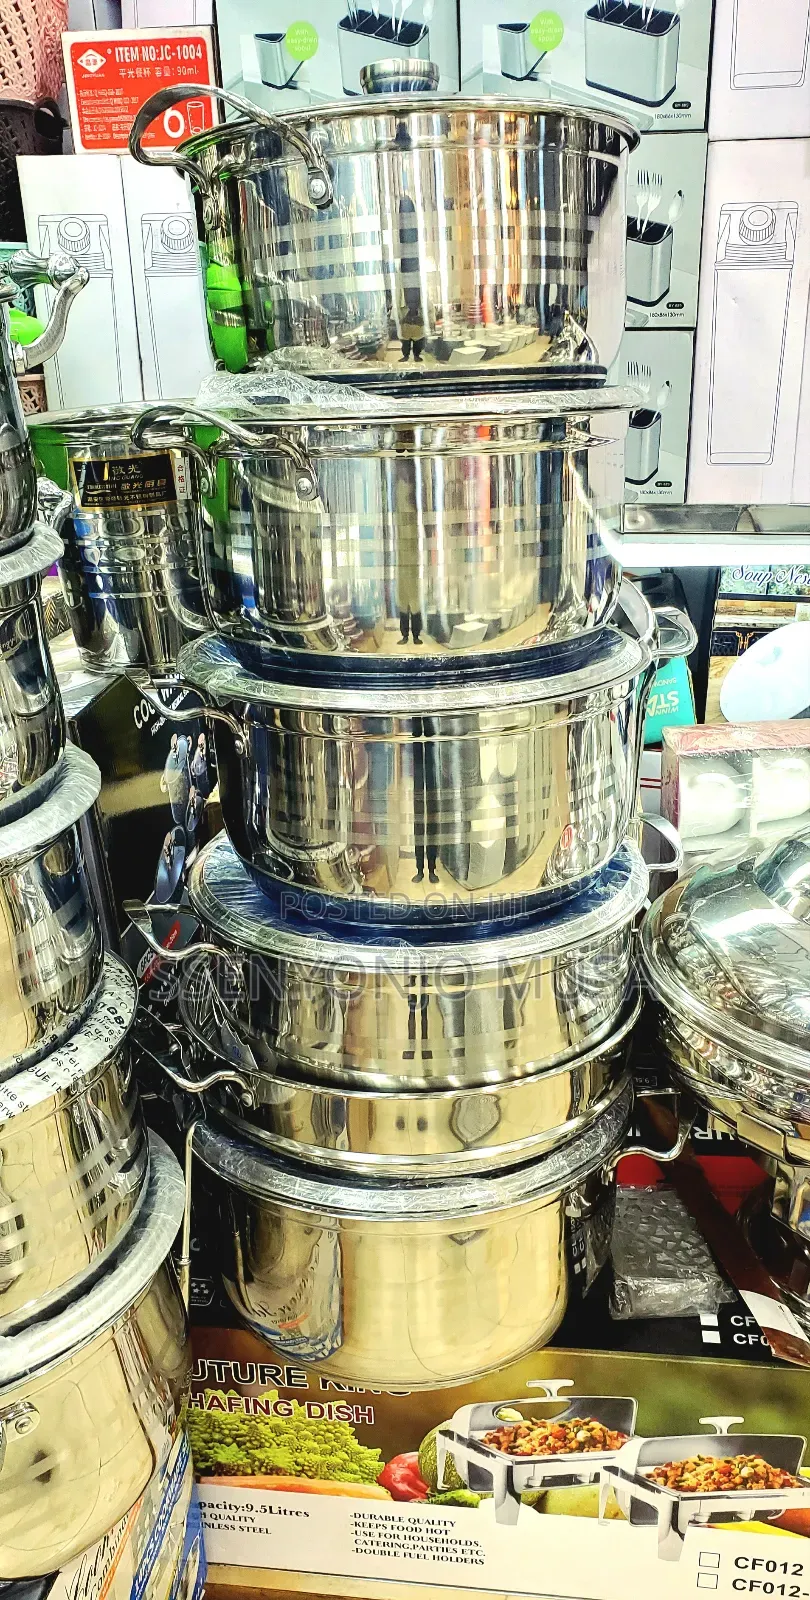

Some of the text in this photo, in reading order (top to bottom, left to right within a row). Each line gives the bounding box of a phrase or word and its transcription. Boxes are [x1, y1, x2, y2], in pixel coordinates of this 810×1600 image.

[115, 45, 139, 62] ITEM
[163, 107, 185, 138] 6
[731, 564, 773, 588] Soup
[305, 1401, 375, 1425] DISH
[209, 1512, 257, 1524] QUALITY
[349, 1512, 457, 1528] -DURABLE QUALITY
[238, 1525, 273, 1536] STEEL
[350, 1521, 451, 1537] -KEEPS FOOD HOT
[350, 1530, 376, 1539] -USE
[378, 1532, 401, 1541] FOR
[351, 1547, 485, 1566] -DOUBLE FUEL HOLDERS
[460, 1548, 487, 1557] ETC.
[733, 1556, 805, 1577] CF012
